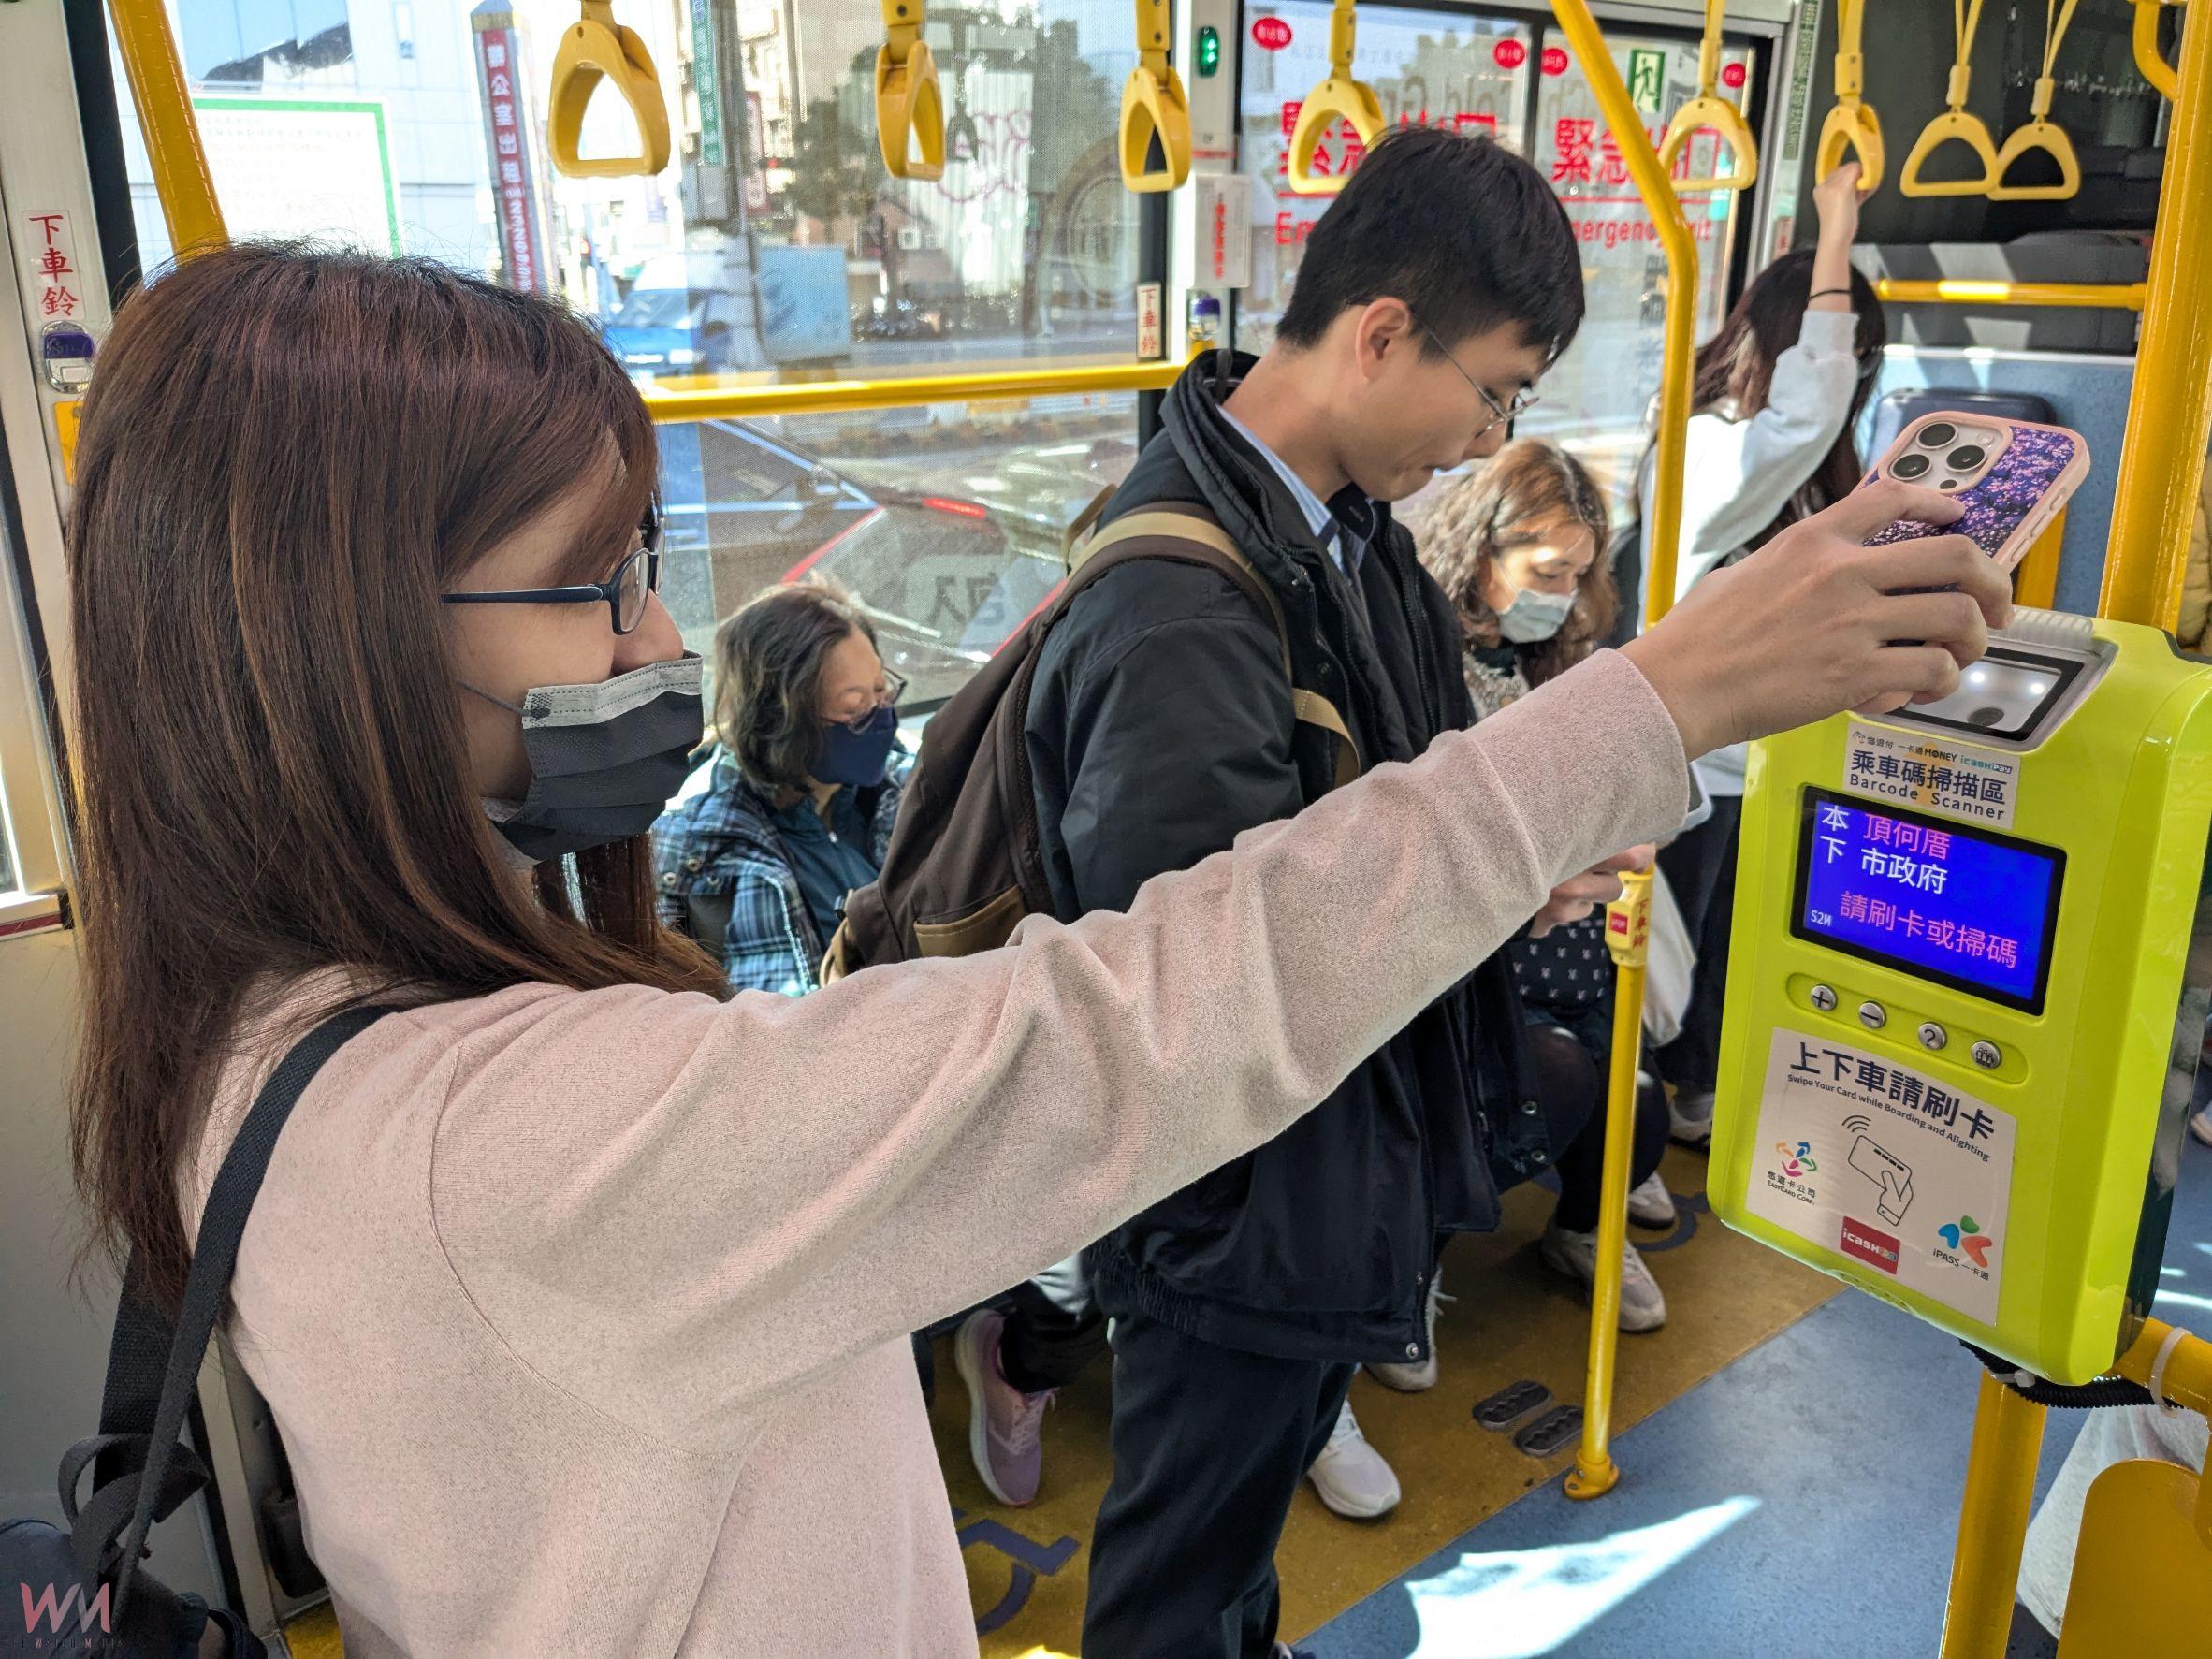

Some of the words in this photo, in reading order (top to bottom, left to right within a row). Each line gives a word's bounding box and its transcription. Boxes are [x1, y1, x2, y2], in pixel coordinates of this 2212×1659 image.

[28, 214, 79, 317] 下車鈴
[1850, 774, 1918, 800] Barcode
[1930, 793, 2005, 820] Scanner
[1851, 749, 2007, 805] 乘車碼掃描區
[1821, 805, 1850, 832] 本
[1862, 812, 1952, 861] 頂何厝
[1819, 835, 1847, 864] 下
[1860, 847, 1948, 895] 市政府
[1810, 910, 1832, 927] S2M
[1840, 890, 2018, 969] 請刷卡或掃碼
[1787, 1074, 1813, 1086] Swipe
[1814, 1080, 1835, 1092] Your
[1836, 1086, 1857, 1099] Card
[1858, 1095, 1884, 1109] while
[1885, 1103, 1927, 1129] Boarding
[1927, 1123, 1946, 1137] and
[1946, 1132, 1990, 1162] Alighting
[1789, 1041, 1995, 1140] 上下車請刷卡
[1932, 1247, 1960, 1267] iPASS
